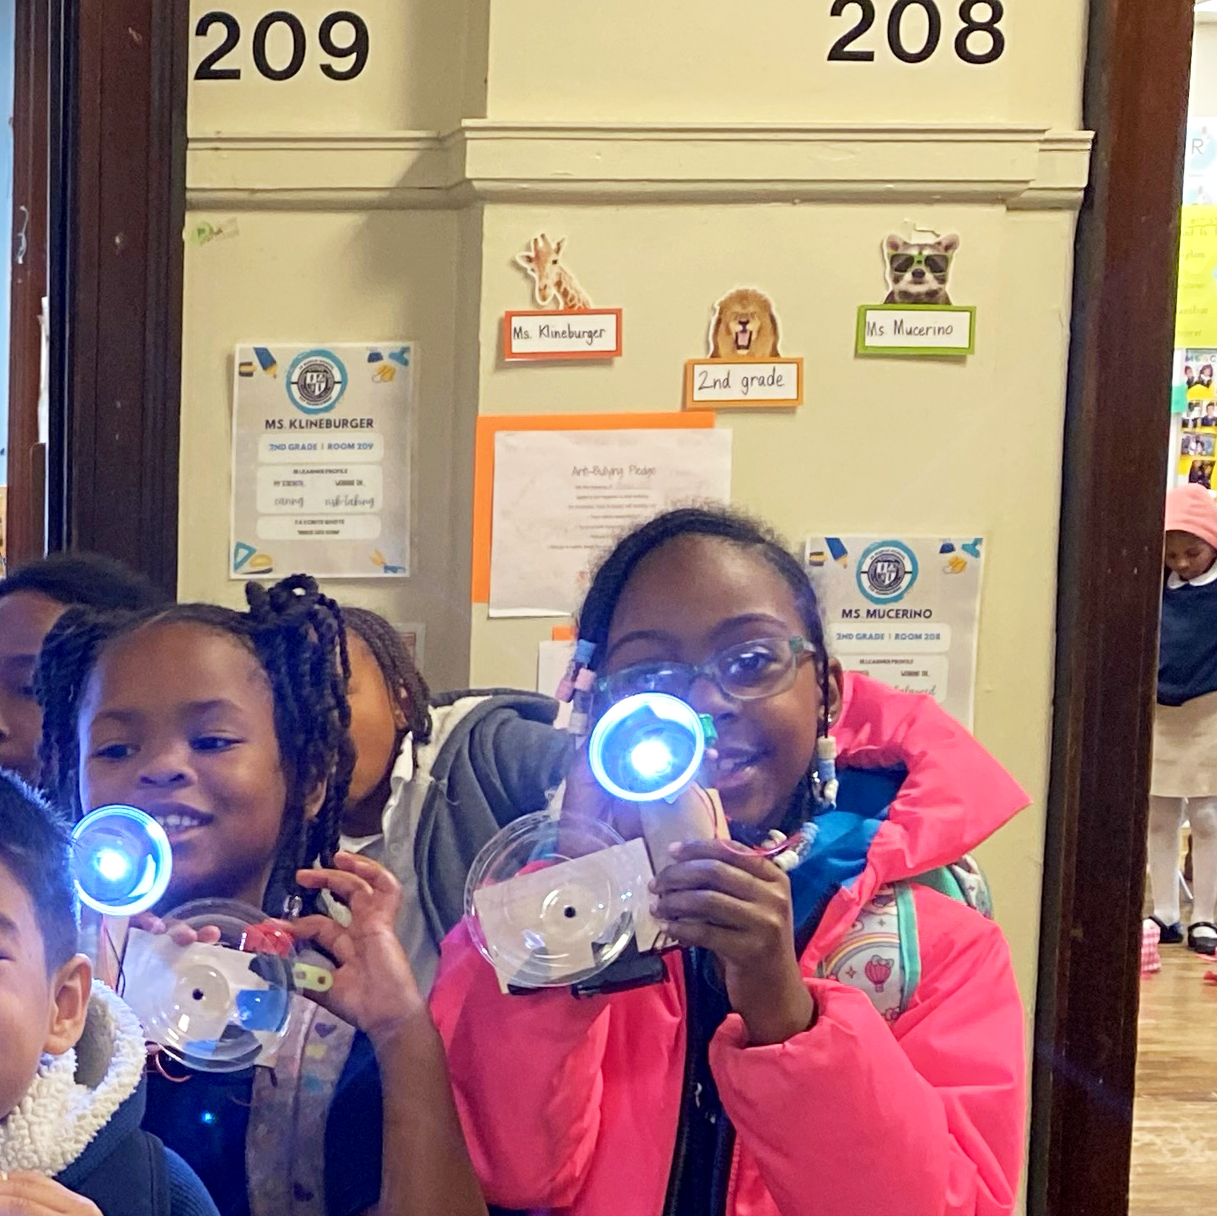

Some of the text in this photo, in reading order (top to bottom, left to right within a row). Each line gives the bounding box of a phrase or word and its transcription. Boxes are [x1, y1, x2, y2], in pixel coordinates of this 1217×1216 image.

[827, 0, 1005, 64] 208
[193, 10, 369, 81] 209
[1191, 138, 1203, 155] R
[513, 322, 606, 346] Ms. Klineburger
[893, 318, 953, 336] Mucerino
[698, 366, 785, 396] 2nd grade
[289, 418, 374, 429] KLINEBURGER
[288, 443, 317, 451] GRADE
[327, 442, 355, 450] ROOM
[357, 442, 374, 450] 209
[865, 608, 933, 620] MUCERINO
[836, 632, 941, 641] 2ND GRADE ROOM 208
